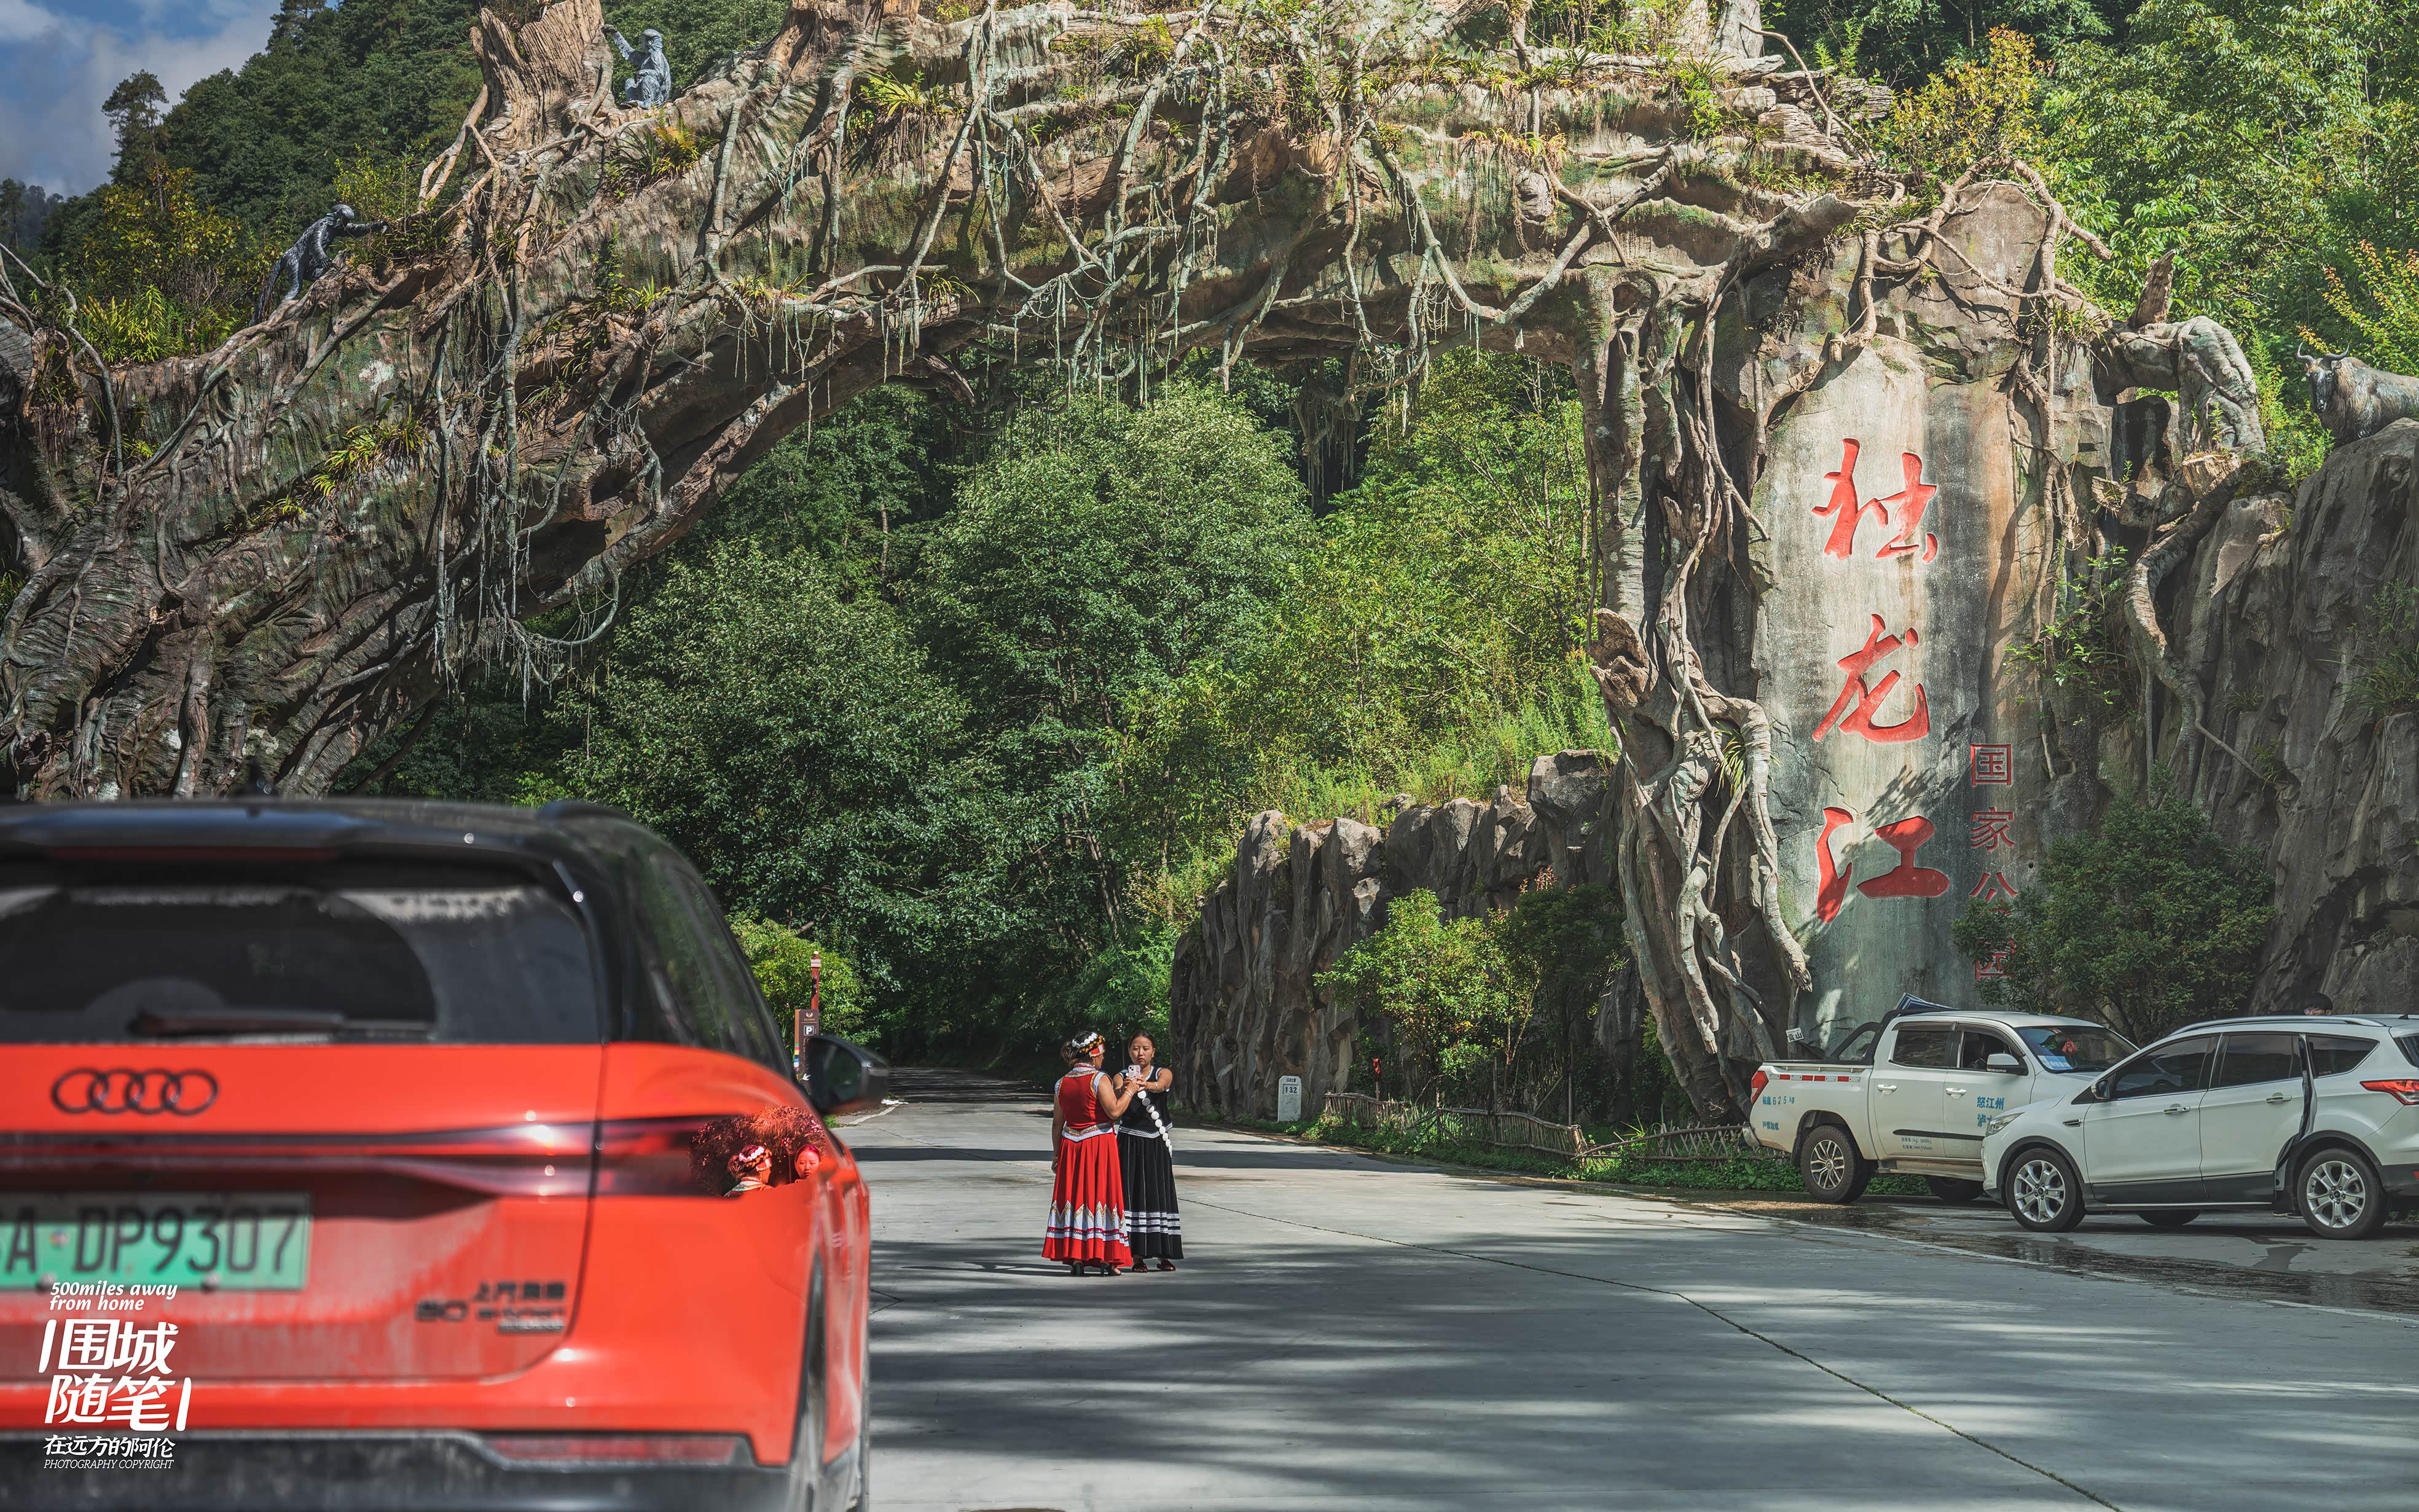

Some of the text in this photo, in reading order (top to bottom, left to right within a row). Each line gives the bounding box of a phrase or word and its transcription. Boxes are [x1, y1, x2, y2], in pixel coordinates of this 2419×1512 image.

[1811, 437, 1950, 923] 独龙江
[1977, 1096, 2004, 1110] 怒江州
